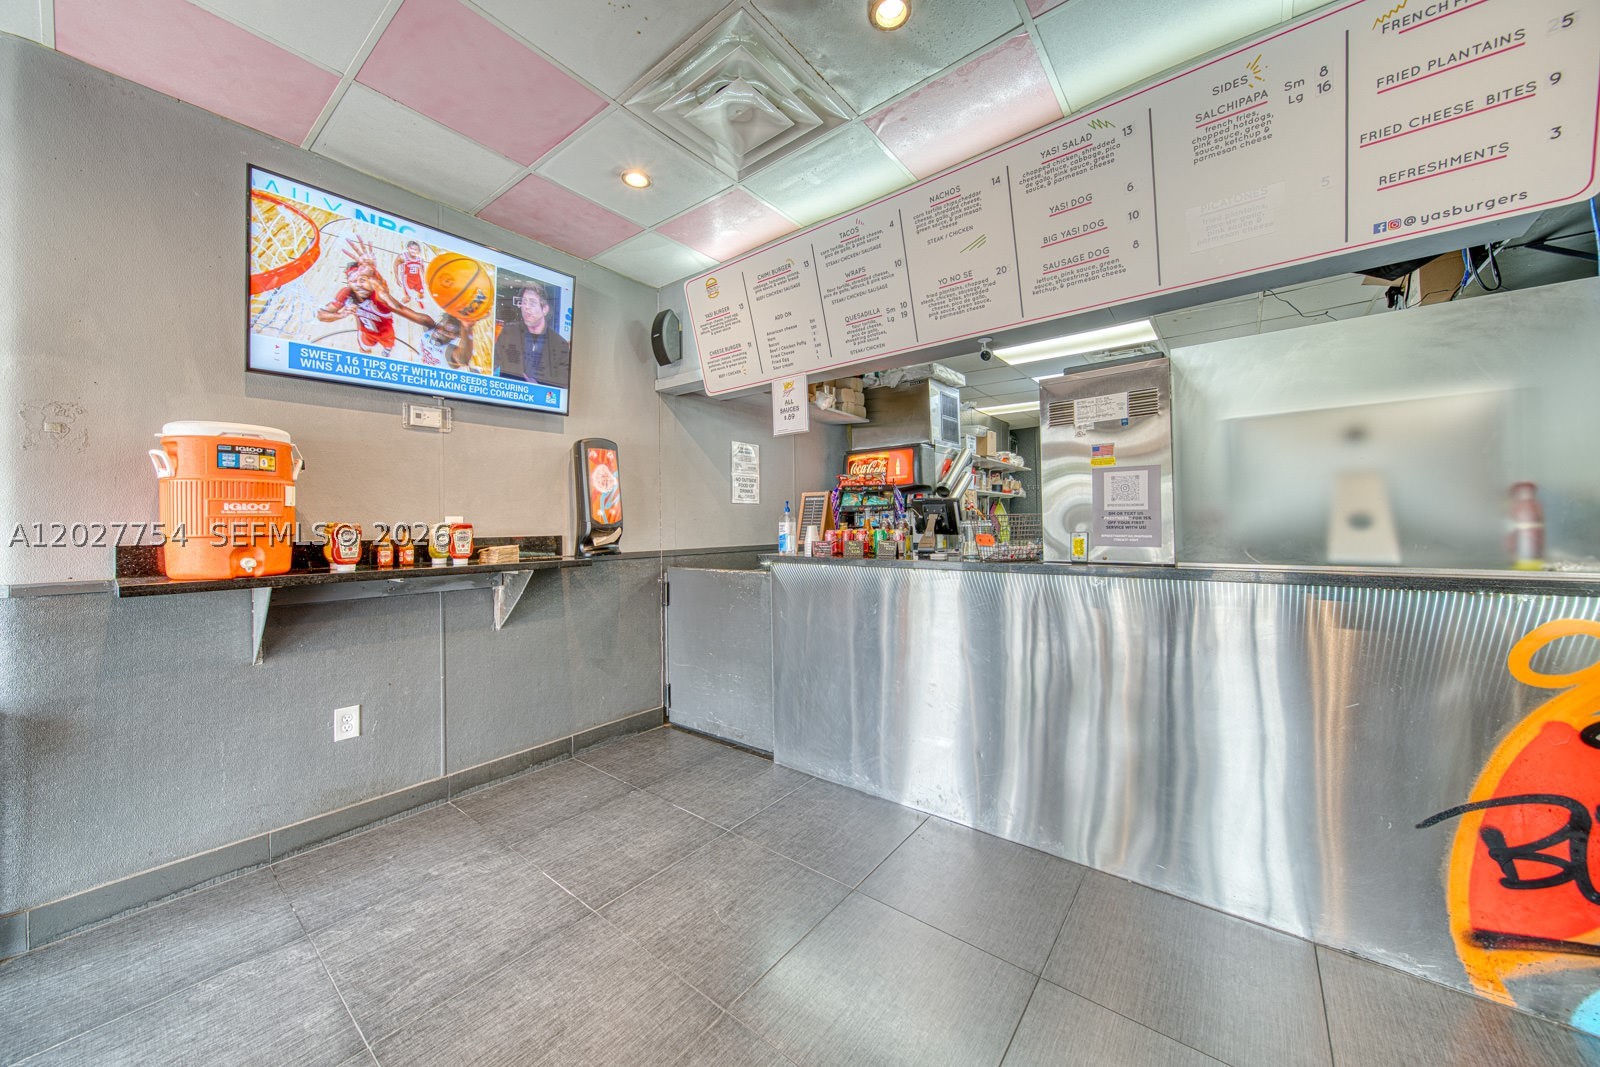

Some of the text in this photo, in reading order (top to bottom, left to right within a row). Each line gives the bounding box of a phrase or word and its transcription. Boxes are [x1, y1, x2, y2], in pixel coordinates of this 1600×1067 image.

[1382, 3, 1448, 34] FRENCH
[1561, 13, 1575, 28] 5
[1377, 28, 1526, 88] FRIED PLANTAINS
[1212, 75, 1248, 96] SIDES
[1317, 81, 1331, 94] 16
[1550, 72, 1561, 85] 9
[1195, 66, 1328, 123] SALCHIPAPA Sm 8
[1205, 111, 1259, 133] french fries,
[1360, 81, 1537, 143] FRIED CHEESE BITES
[1062, 133, 1092, 151] SALAD
[1122, 125, 1133, 137] 13
[1192, 113, 1274, 145] chopped hotdogs,
[1193, 119, 1272, 152] pink sauce, green
[1550, 126, 1562, 140] 3
[1193, 133, 1272, 165] parmesan cheese
[1195, 145, 1223, 157] sauce,
[1225, 130, 1260, 148] ketchup
[1019, 143, 1120, 185] cheese, lettuce, cabbage, pico
[1022, 138, 1116, 178] chopped chicken, shredded
[1379, 142, 1510, 186] REFRESHMENTS
[1025, 180, 1033, 189] de
[1054, 168, 1068, 180] pink
[1070, 161, 1088, 173] sauce,
[1090, 152, 1114, 166] green
[1054, 168, 1088, 186] parmesan
[1090, 158, 1114, 171] cheese
[929, 176, 1000, 203] NACHOS 14
[1127, 182, 1134, 191] 6
[1071, 193, 1092, 206] DOG
[914, 212, 924, 220] corn
[935, 204, 959, 217] shredded
[951, 208, 962, 218] pink
[955, 207, 982, 222] parmesan
[1128, 210, 1139, 220] 10
[840, 226, 859, 239] TACOS
[927, 236, 944, 245] STEAK
[949, 225, 974, 238] CHICKEN
[939, 221, 958, 230] cheese
[1043, 234, 1058, 244] BIG
[1083, 219, 1104, 232] DOG
[1133, 240, 1139, 248] 8
[772, 263, 791, 275] BURGER
[845, 259, 902, 278] WRAPS 10
[1043, 247, 1110, 271] SAUSAGE DOG
[1060, 268, 1074, 279] pink
[1100, 258, 1120, 270] green
[938, 266, 1007, 286] YO NO SE 20
[1056, 270, 1089, 285] shoestring
[1066, 274, 1100, 290] parmesan
[1101, 267, 1126, 280] cheese
[845, 308, 880, 322] QUESADILLA
[300, 348, 529, 393] SWEET 16 TIPS OFF WITH TOP SEEDS SECURING
[300, 358, 332, 372] WINS
[336, 363, 360, 376] AND
[363, 368, 398, 381] TEXAS
[401, 374, 427, 386] TECH
[430, 378, 467, 392] MAKING
[469, 384, 488, 395] EPIC
[490, 388, 534, 402] COMEBACK
[224, 502, 269, 510] IGLOO
